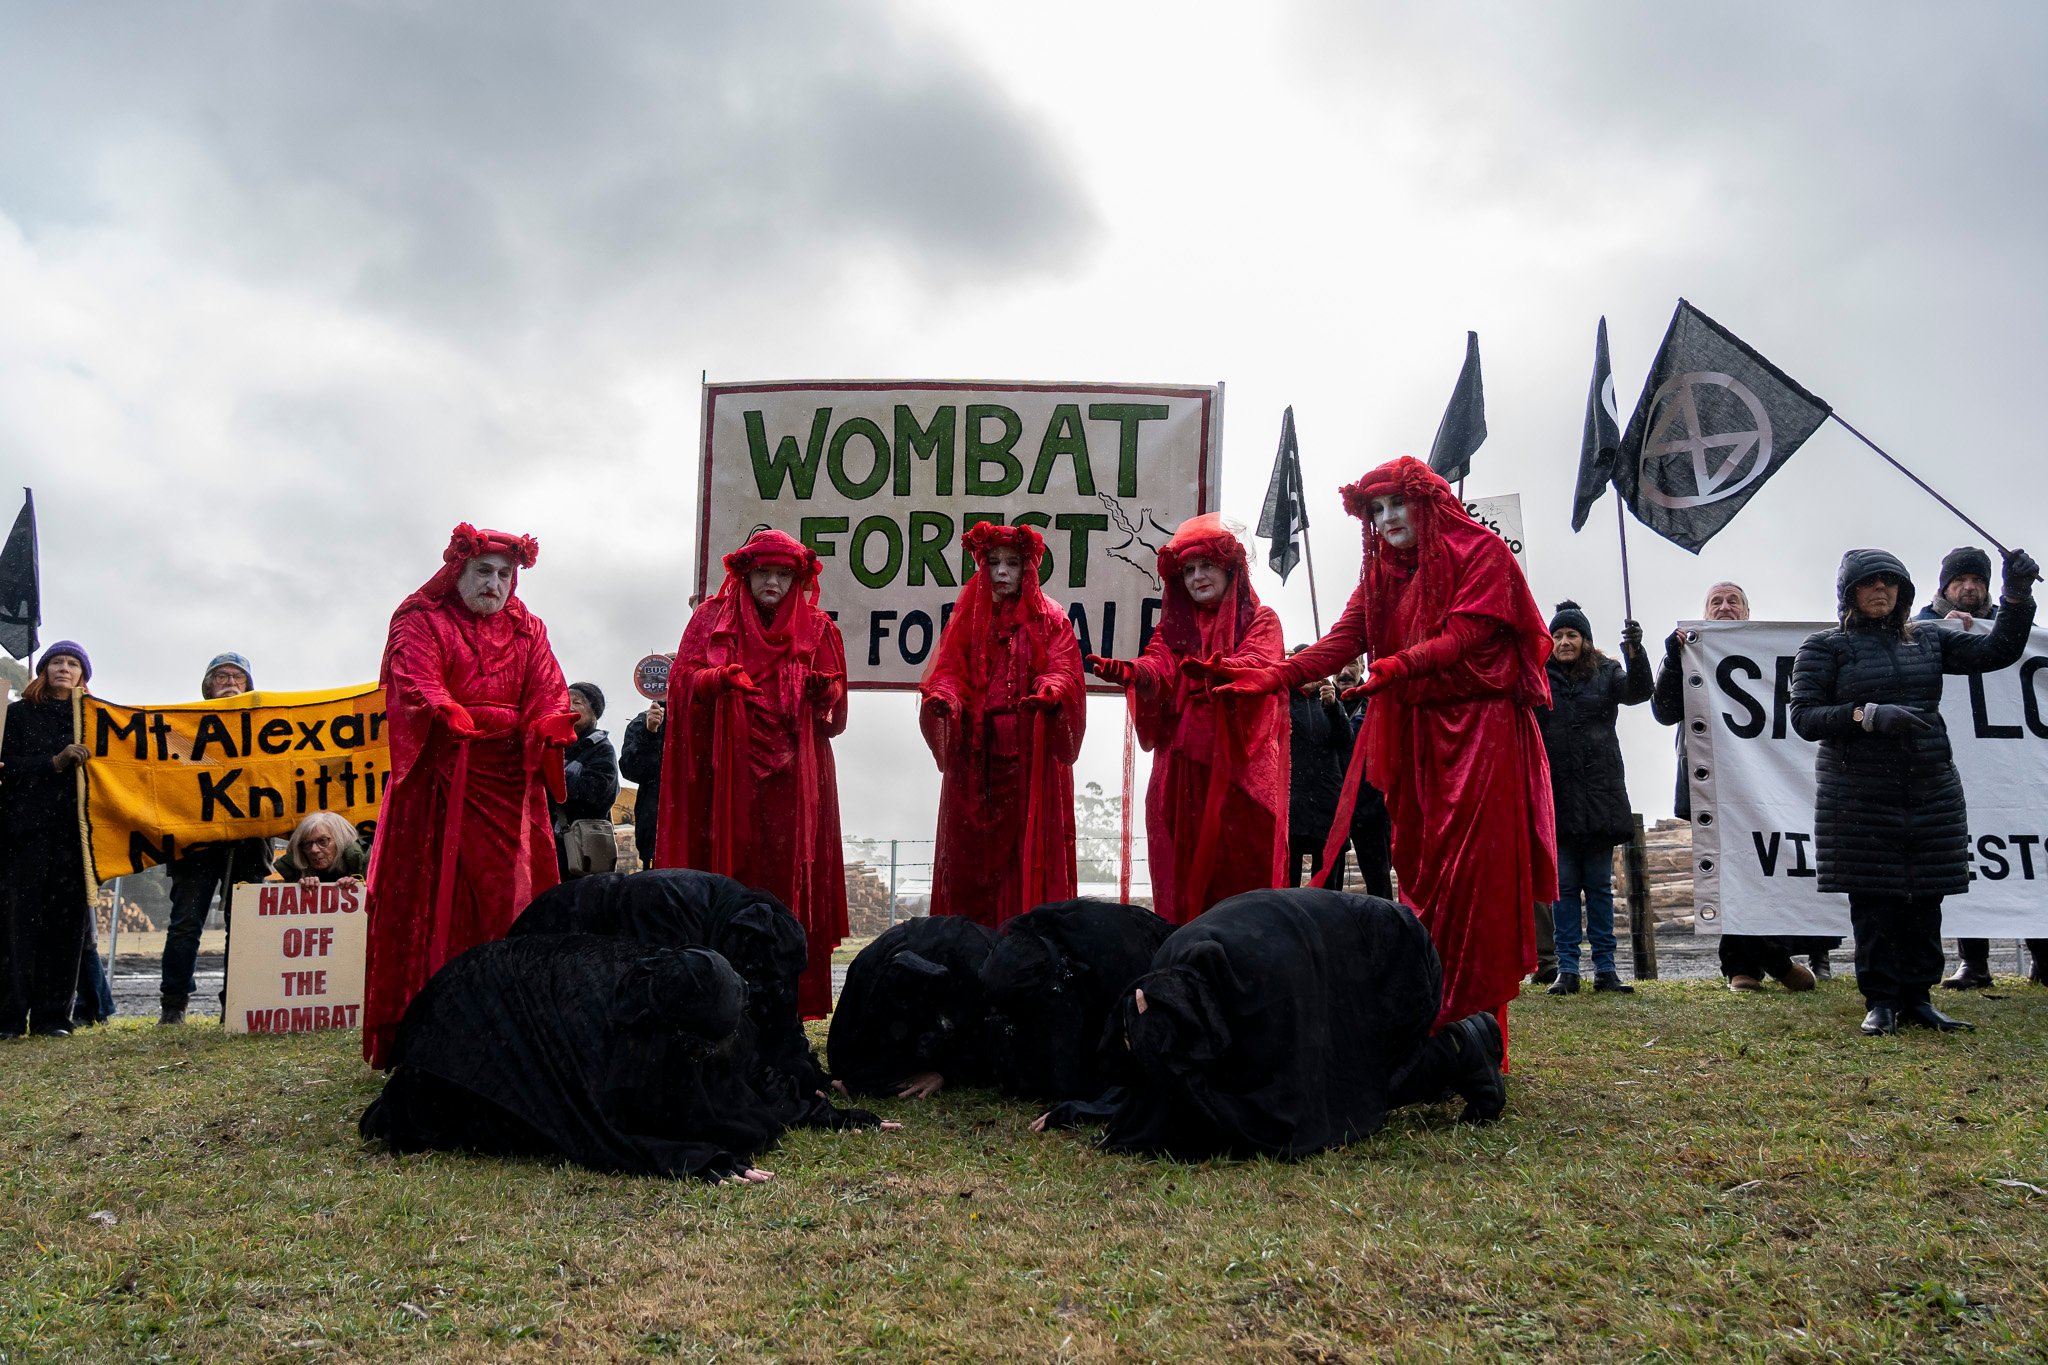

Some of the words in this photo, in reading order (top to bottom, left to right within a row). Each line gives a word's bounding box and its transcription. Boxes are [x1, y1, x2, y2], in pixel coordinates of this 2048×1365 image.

[743, 404, 1169, 500] WOMBAT
[645, 666, 668, 674] BUG
[96, 708, 180, 760] Mt.
[198, 761, 391, 821] Knitti
[259, 886, 359, 916] HANDS
[283, 927, 333, 958] OFF
[282, 971, 326, 996] THE
[246, 1004, 360, 1034] WOMBAT
